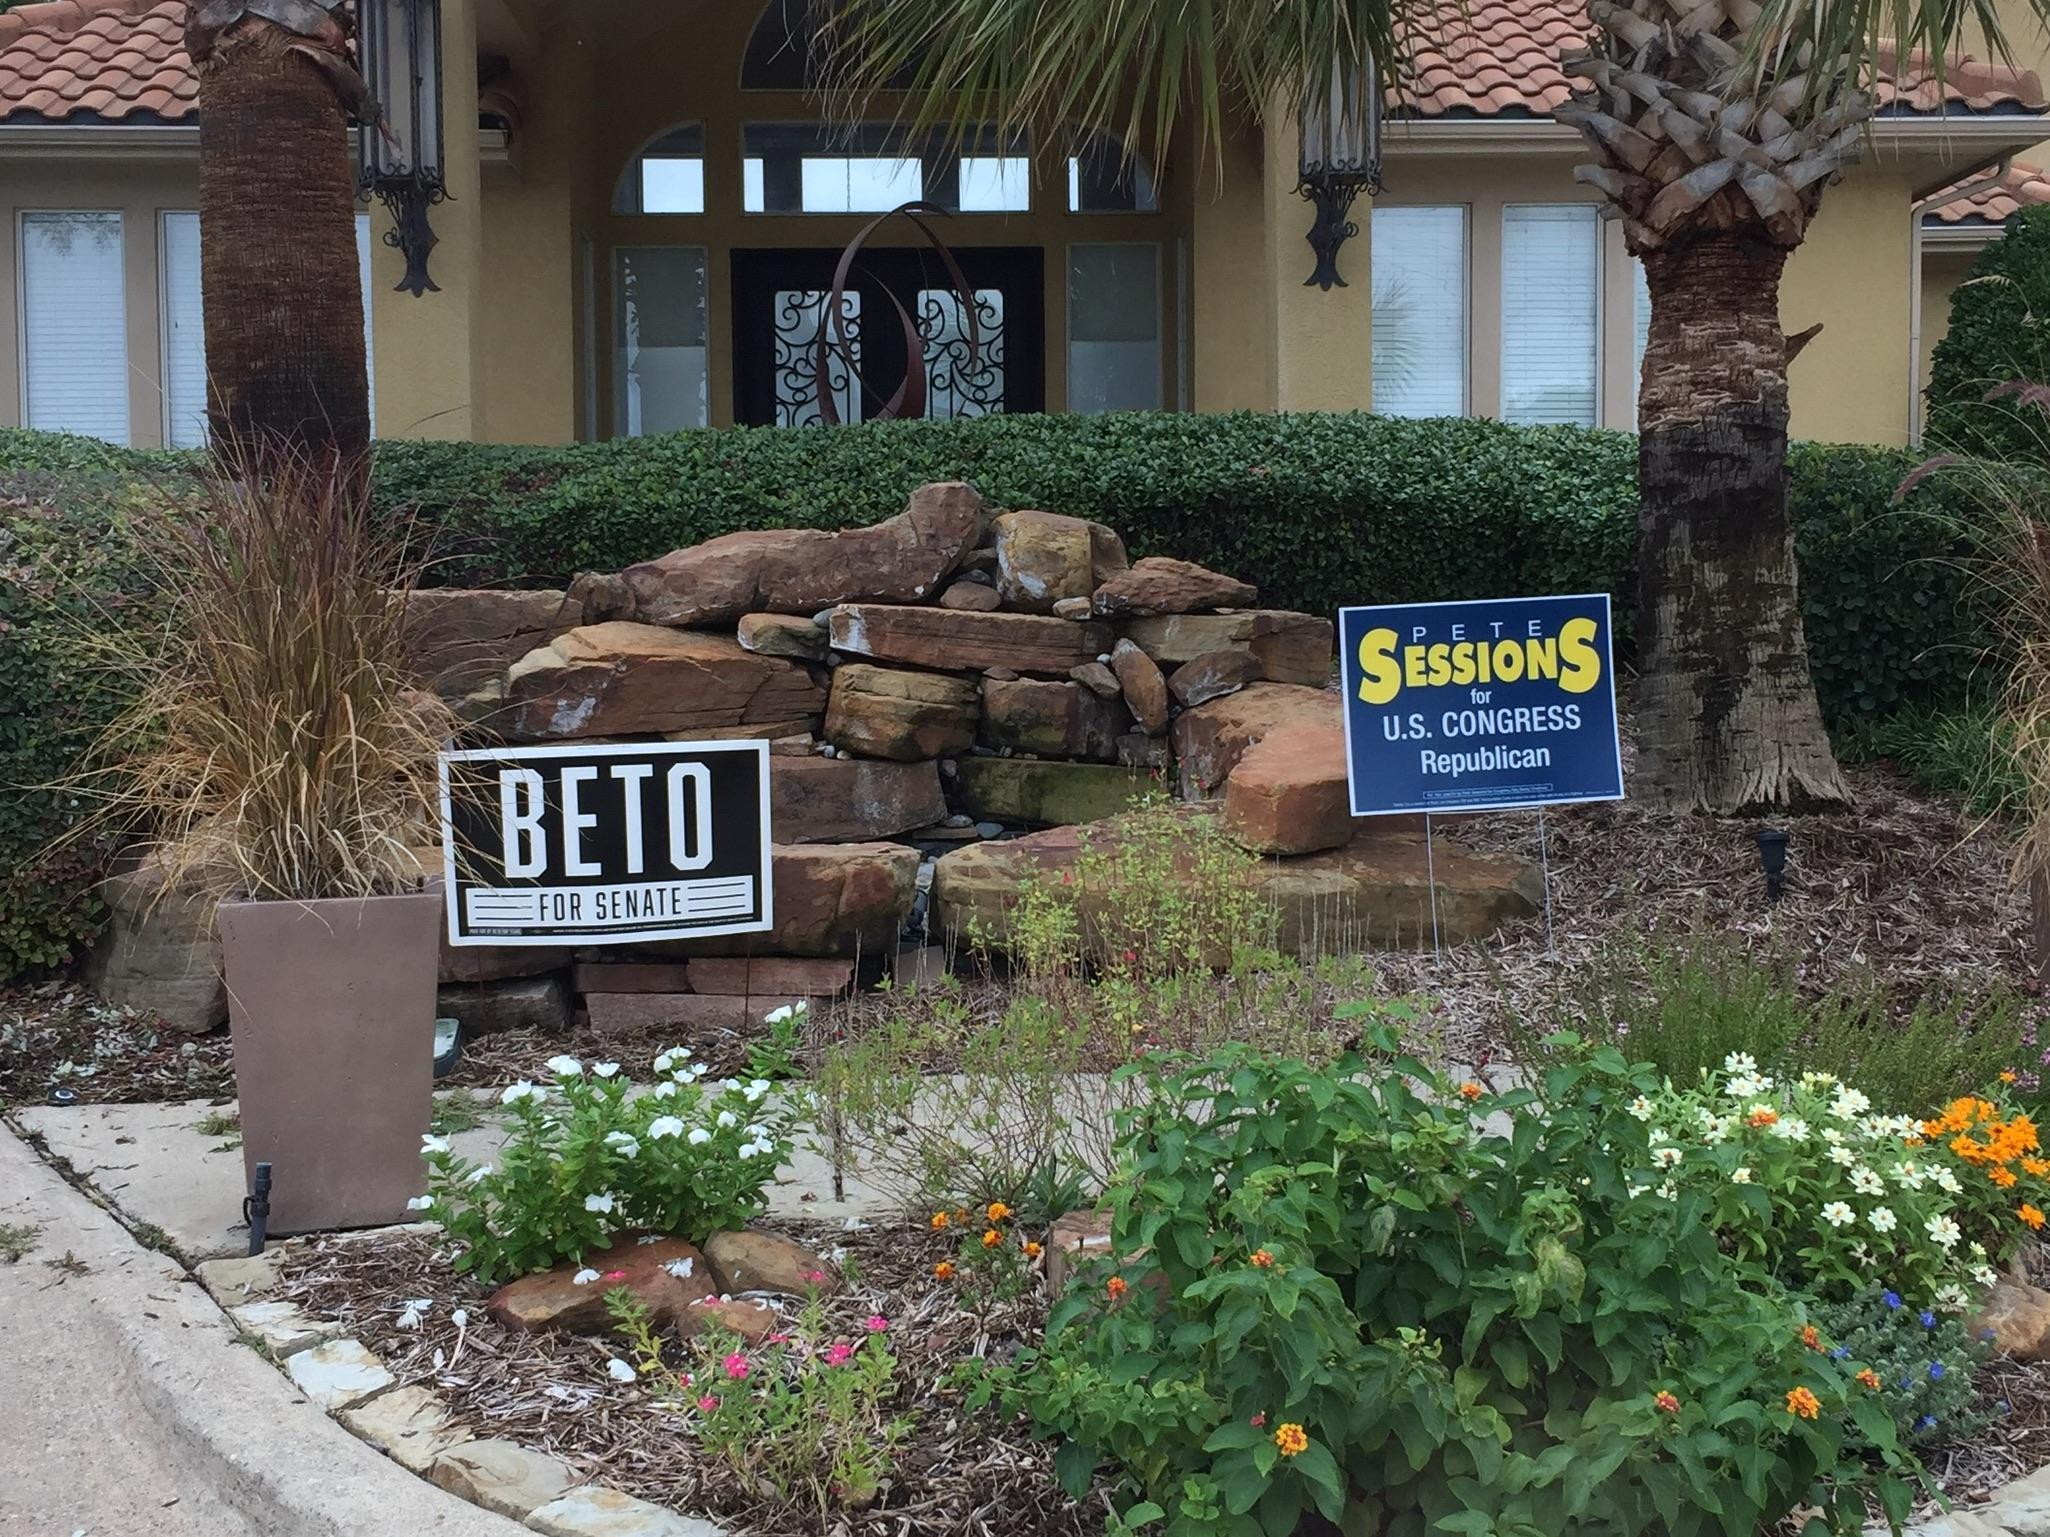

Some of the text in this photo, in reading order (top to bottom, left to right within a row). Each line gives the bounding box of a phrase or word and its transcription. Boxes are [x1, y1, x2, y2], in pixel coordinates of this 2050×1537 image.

[1412, 620, 1542, 643] PETE
[1358, 617, 1601, 705] SESSIONS
[1470, 688, 1492, 704] for
[1382, 704, 1582, 741] U.S. CONGRESS
[1420, 745, 1551, 778] Republican
[500, 762, 713, 878] BETO
[539, 887, 681, 921] FOR SENATE
